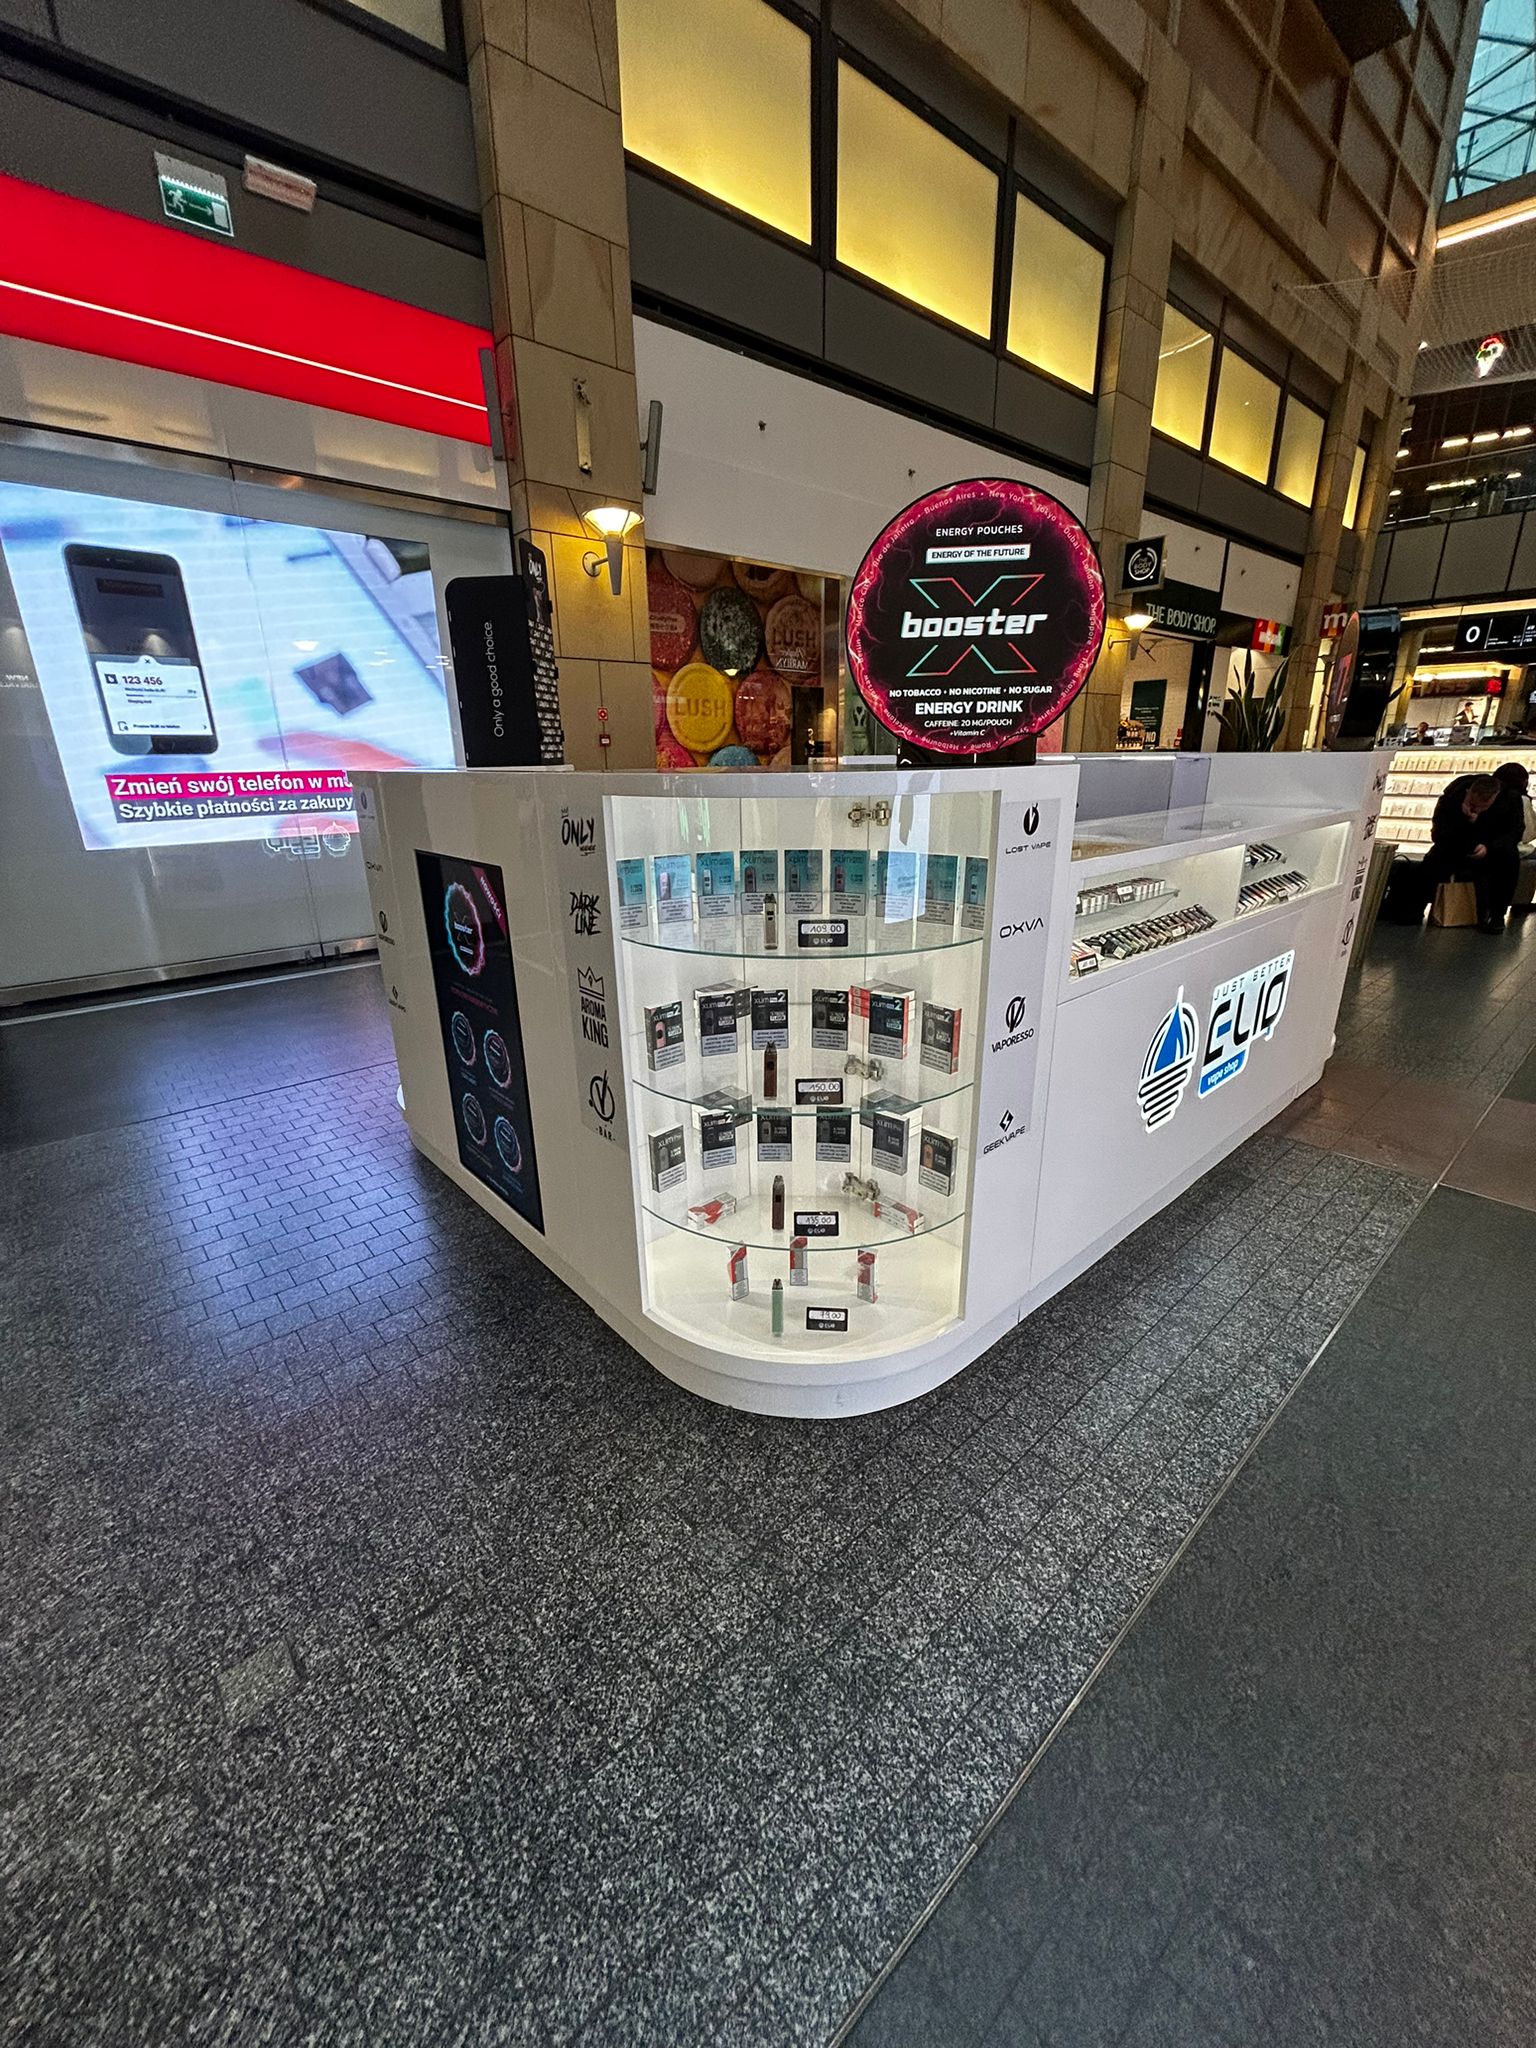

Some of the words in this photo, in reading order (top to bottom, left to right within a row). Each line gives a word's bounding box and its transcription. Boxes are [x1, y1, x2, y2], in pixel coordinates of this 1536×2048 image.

[924, 497, 953, 514] Buenos
[955, 492, 976, 501] Aires
[988, 490, 1005, 498] New
[1008, 492, 1026, 503] York
[1035, 504, 1057, 521] Tokyo
[882, 543, 891, 553] de
[890, 518, 915, 543] Janeiro
[935, 526, 974, 537] ENERGY
[976, 524, 1023, 535] POUCHES
[1063, 528, 1081, 549] Dubai
[931, 550, 962, 559] ENERGY
[963, 550, 974, 558] OF
[976, 549, 992, 557] THE
[993, 547, 1026, 556] FUTURE
[1081, 559, 1095, 590] London
[900, 608, 1048, 638] booster
[1146, 602, 1165, 625] THE
[1166, 608, 1193, 630] BODY
[773, 627, 816, 648] LUSH
[122, 676, 142, 684] 123
[143, 676, 163, 685] 456
[488, 664, 503, 697] good
[889, 689, 902, 697] NO
[903, 688, 941, 697] TOBACCO
[949, 687, 961, 696] NO
[962, 686, 1001, 695] NICOTINE
[1008, 686, 1022, 694] NO
[1023, 685, 1052, 694] SUGAR
[494, 698, 501, 708] a
[674, 698, 726, 718] LUSH
[915, 701, 973, 715] ENERGY
[976, 700, 1023, 713] DRINK
[494, 708, 505, 737] Only
[883, 708, 913, 735] Barcelona
[960, 719, 971, 727] 20
[971, 718, 1012, 727] MG/POUCH
[921, 735, 960, 751] Melbourne
[111, 778, 182, 796] Zmień
[187, 776, 235, 796] swój
[237, 774, 304, 792] telefon
[308, 776, 322, 789] w
[119, 801, 193, 823] Szybkie
[197, 799, 275, 817] płatności
[278, 801, 297, 811] za
[300, 794, 353, 811] zakupy
[561, 817, 595, 847] ONLY
[1005, 844, 1029, 855] LOST
[1031, 841, 1052, 851] VAPE
[569, 889, 601, 916] DARK
[574, 912, 602, 936] LINE
[999, 916, 1044, 939] OXVA
[1214, 977, 1245, 1001] JUST
[1252, 953, 1293, 982] BETTER
[725, 995, 733, 1006] 2
[777, 991, 786, 1002] 2
[837, 992, 846, 1003] 2
[894, 999, 902, 1010] 2
[580, 996, 607, 1022] AROMA
[673, 1004, 681, 1016] 2
[944, 1011, 952, 1022] 2
[582, 1014, 609, 1049] KING
[991, 1028, 1035, 1053] VAPORESSO
[1207, 1068, 1224, 1087] vape
[1223, 1058, 1239, 1077] shop
[725, 1113, 733, 1123] 2
